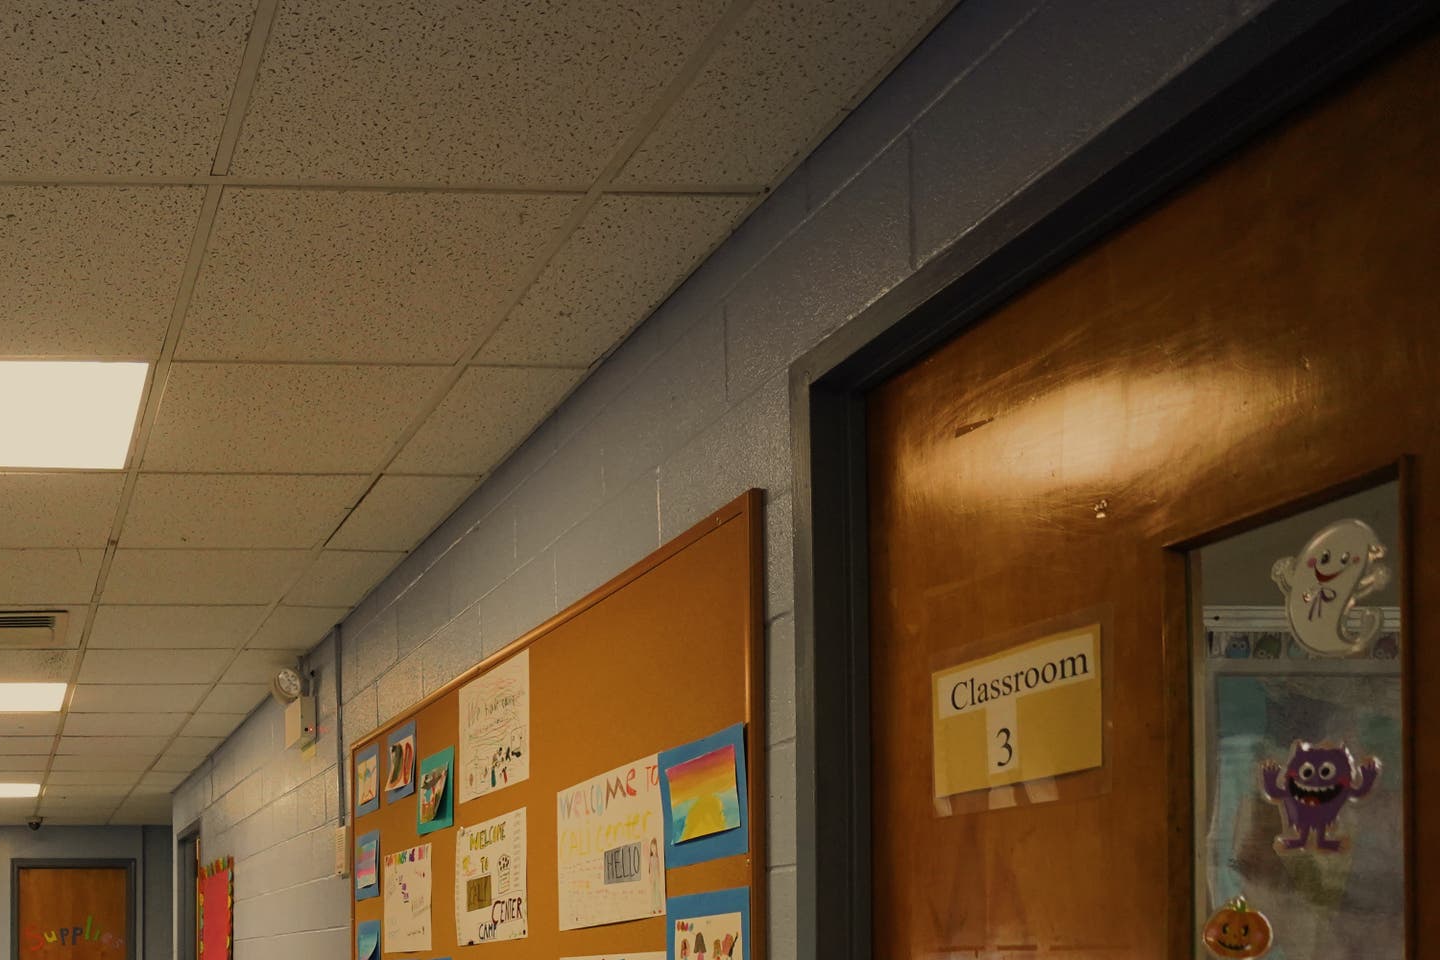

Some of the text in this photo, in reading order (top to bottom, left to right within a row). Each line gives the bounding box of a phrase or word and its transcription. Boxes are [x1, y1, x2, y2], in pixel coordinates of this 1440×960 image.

[951, 652, 1089, 711] Classroom
[995, 727, 1013, 767] 3
[606, 846, 641, 881] HELLO
[491, 897, 522, 926] CENTER
[478, 922, 497, 940] CAMP
